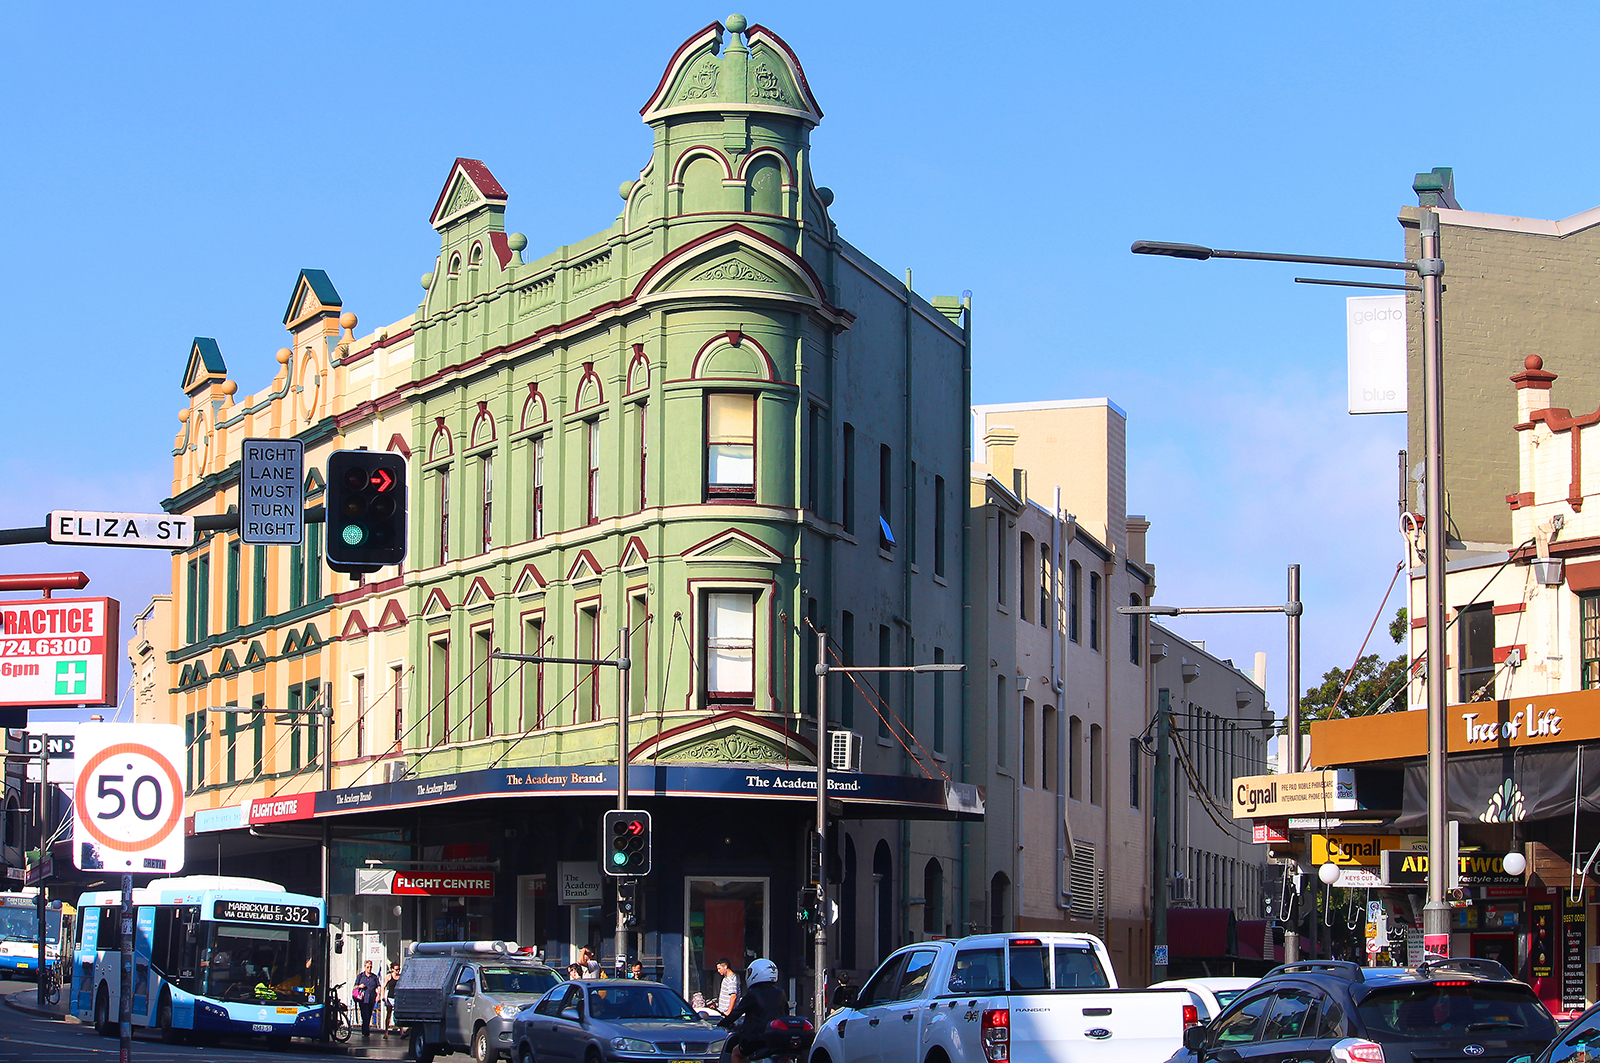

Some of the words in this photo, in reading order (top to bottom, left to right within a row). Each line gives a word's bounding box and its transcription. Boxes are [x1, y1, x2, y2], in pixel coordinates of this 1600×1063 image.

[1353, 307, 1403, 325] gelato
[1362, 388, 1396, 402] blue
[249, 448, 296, 462] RIGHT
[250, 467, 295, 480] LANE
[251, 485, 294, 498] MUST
[251, 503, 295, 517] TURN
[60, 517, 139, 538] ELIZA
[156, 521, 187, 540] ST
[248, 522, 296, 537] RIGHT
[1462, 713, 1500, 744] Tree
[1502, 712, 1524, 740] of
[1526, 703, 1563, 737] Life
[28, 739, 75, 753] DND
[506, 774, 523, 785] The
[525, 773, 568, 787] Academy
[746, 775, 770, 787] The
[772, 776, 817, 789] Academ
[417, 785, 425, 795] The
[425, 783, 443, 795] Academy
[1281, 784, 1289, 792] PRE
[1289, 783, 1297, 791] PAID
[97, 775, 162, 821] 50
[336, 795, 344, 804] The
[343, 794, 359, 805] Academy
[1237, 782, 1277, 812] Cignall
[1281, 794, 1308, 803] INTERNATIONAL
[251, 801, 273, 818] FLIGHT
[273, 799, 298, 815] CENTRE
[1269, 828, 1285, 838] HERE
[1326, 838, 1381, 862] Cignall
[397, 878, 442, 889] FLIGHT
[443, 879, 491, 889] CENTRE
[564, 882, 600, 891] Academy
[228, 902, 281, 914] MARRICKVILLE
[236, 912, 273, 921] CLEVELAND
[284, 906, 310, 923] 352
